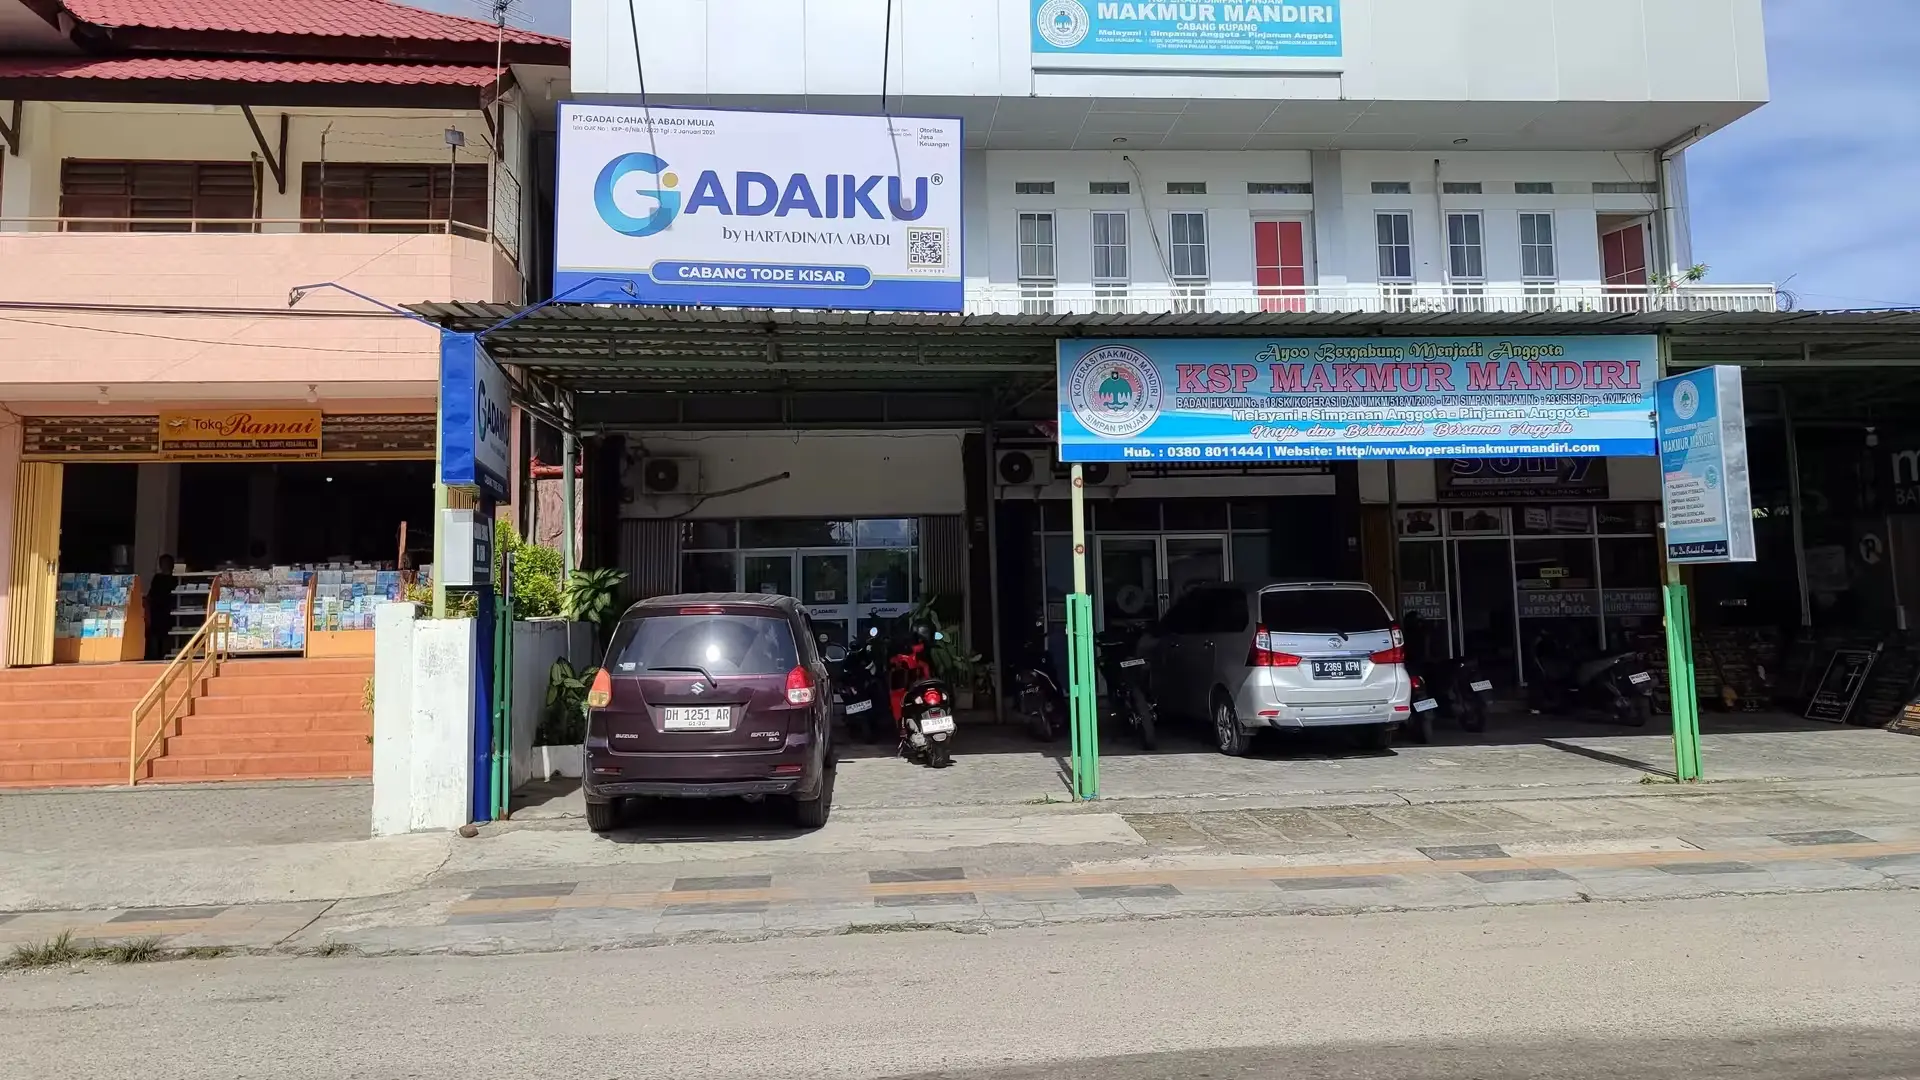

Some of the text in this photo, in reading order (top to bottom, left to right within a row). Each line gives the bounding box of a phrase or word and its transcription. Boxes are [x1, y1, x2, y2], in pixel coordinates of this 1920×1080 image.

[1098, 3, 1333, 22] MAKMUR MANDIRI
[1176, 22, 1258, 32] CABANG KUPANG
[616, 116, 656, 125] CAHAYA
[658, 118, 686, 126] ABADI
[687, 118, 715, 127] MULIA
[722, 226, 891, 246] by HARTADINATA ABADI
[678, 266, 846, 282] CABANG TODE KISAR
[1255, 342, 1564, 364] Ayoo Bergabung Menjadi Anggota
[1073, 350, 1158, 398] KOPERASI MAKMUR MANDIRI
[1176, 360, 1642, 394] KSP MAKMUR MANDIRI
[1176, 397, 1208, 408] BADAN
[1210, 397, 1244, 408] HUKUM
[1244, 396, 1259, 408] No.
[1340, 396, 1360, 408] DAN
[1442, 395, 1458, 406] IZIN
[1460, 395, 1492, 406] SIMPAN
[1494, 394, 1526, 406] PINJAM
[1527, 394, 1539, 406] No
[1085, 412, 1148, 433] SIMPAN PINJAM
[1232, 408, 1299, 422] Melayani
[1310, 409, 1384, 422] Simpanan
[1386, 408, 1448, 422] Anggota
[1458, 408, 1527, 422] Pinjaman
[1530, 407, 1589, 421] Anggota
[192, 413, 317, 436] Toko Ramai
[1249, 420, 1574, 442] Maju dan Bertumbuh Bersama Anggota
[1124, 446, 1156, 457] Hub.
[1167, 446, 1201, 457] 0380
[1204, 446, 1263, 457] 8011444
[1274, 446, 1332, 457] Website:
[1314, 662, 1360, 672] B 2369 KFM
[666, 708, 729, 720] DH 1251 AR
